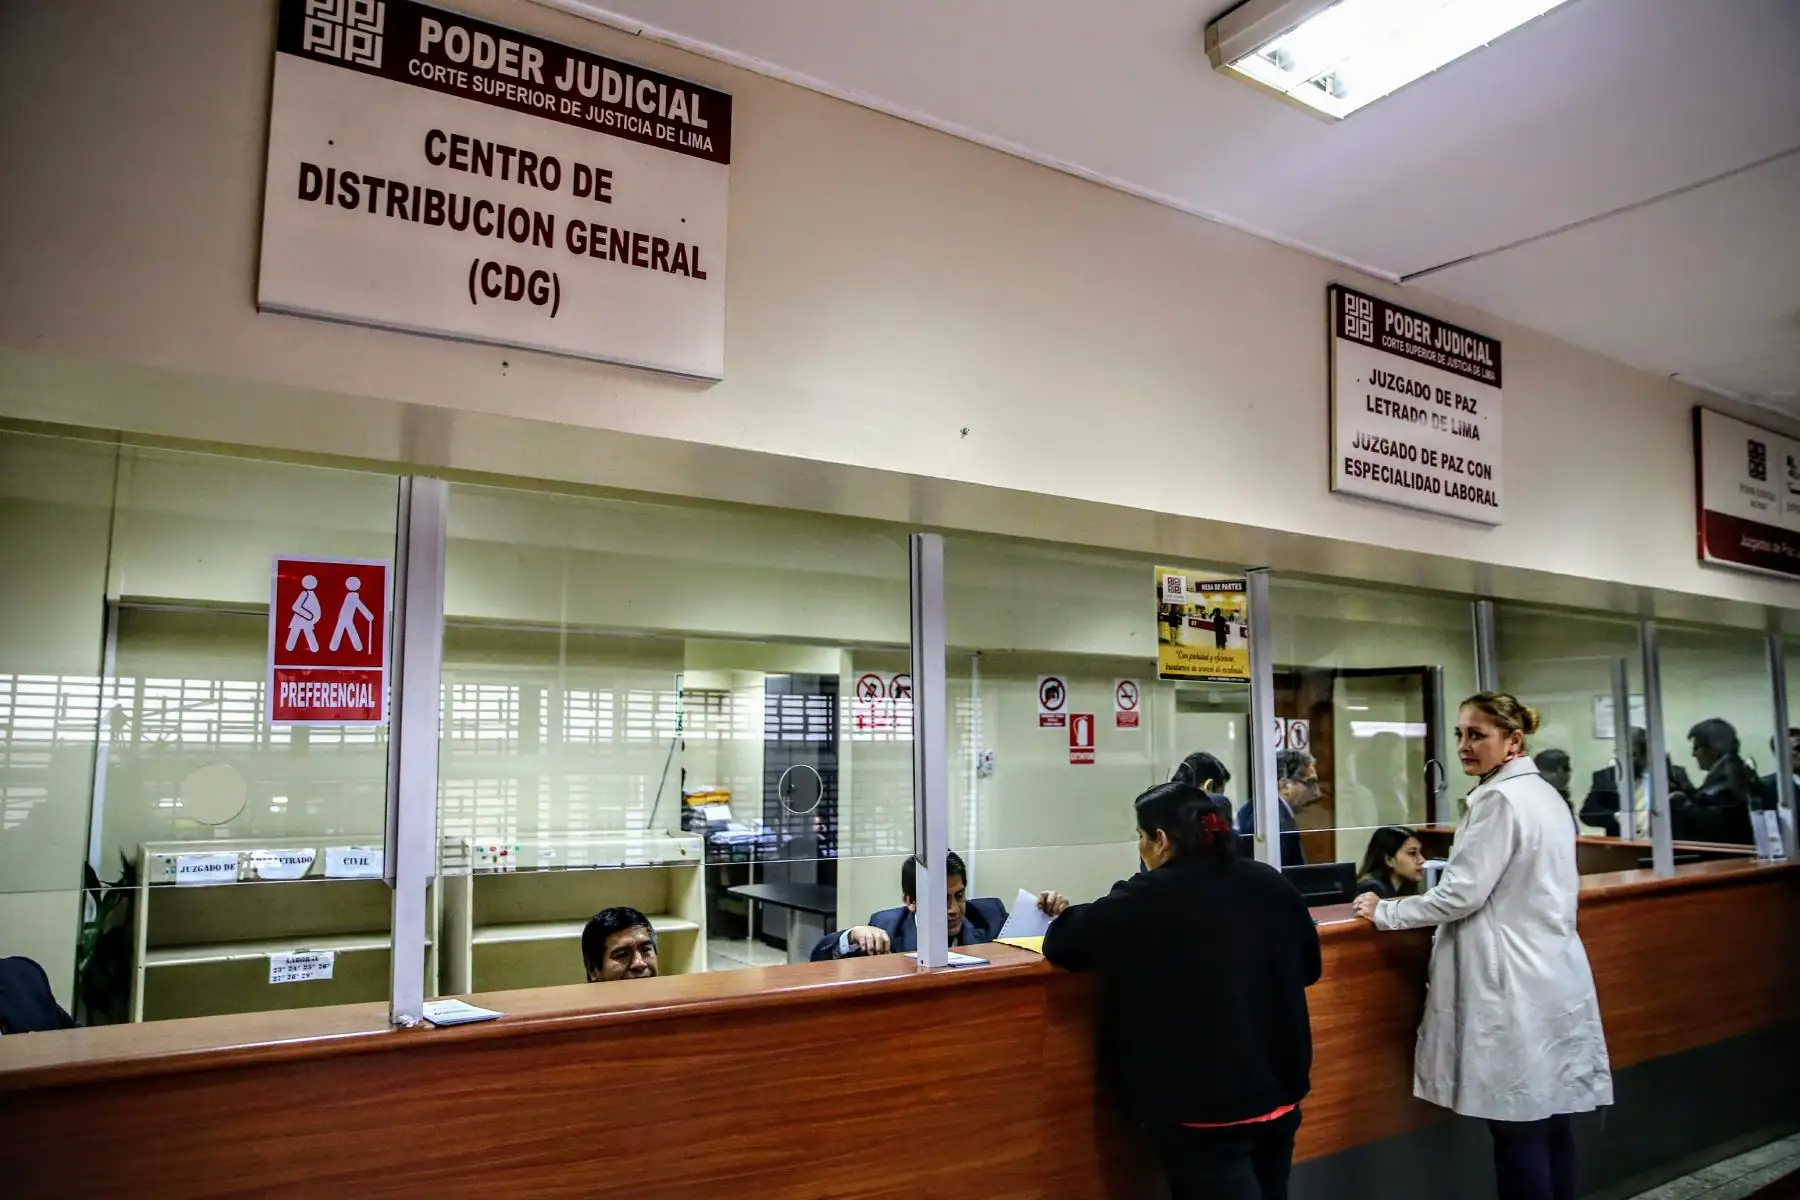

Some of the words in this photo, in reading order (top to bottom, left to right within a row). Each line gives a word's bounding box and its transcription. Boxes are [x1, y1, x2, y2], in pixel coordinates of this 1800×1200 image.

[420, 17, 544, 85] PODER
[555, 57, 709, 129] JUDICIAL
[408, 58, 467, 89] CORTE
[472, 75, 556, 112] SUPERIOR
[560, 97, 582, 118] DE
[585, 104, 652, 136] JUSTICIA
[656, 122, 676, 141] DE
[680, 129, 713, 153] LIMA
[425, 129, 561, 191] CENTRO
[573, 163, 613, 204] DE
[298, 162, 555, 249] DISTRIBUCION
[566, 219, 707, 281] GENERAL
[468, 258, 561, 318] (CDG)
[1382, 335, 1404, 352] CORTE
[1405, 342, 1437, 362] SUPERIOR
[1437, 353, 1446, 365] DE
[1447, 356, 1473, 373] JUSTICIA
[1473, 364, 1481, 377] DE
[1481, 367, 1496, 381] LIMA
[1385, 308, 1432, 346] PODER
[1434, 327, 1493, 366] JUDICIAL
[1369, 368, 1431, 401] JUZGADO
[1436, 387, 1452, 407] DE
[1455, 394, 1478, 415] PAZ
[1366, 394, 1428, 428] LETRADO
[1432, 412, 1448, 432] DE
[1451, 418, 1480, 441] LIMA
[1352, 430, 1417, 462] JUZGADO
[1421, 448, 1437, 468] DE
[1442, 453, 1464, 474] PAZ
[1467, 460, 1492, 481] CON
[1344, 457, 1440, 494] ESPECIALIDAD
[1444, 479, 1498, 508] LABORAL
[280, 681, 376, 708] PREFERENCIAL
[180, 864, 222, 873] JUZGADO
[224, 863, 236, 871] DE
[343, 857, 369, 866] CIVIL
